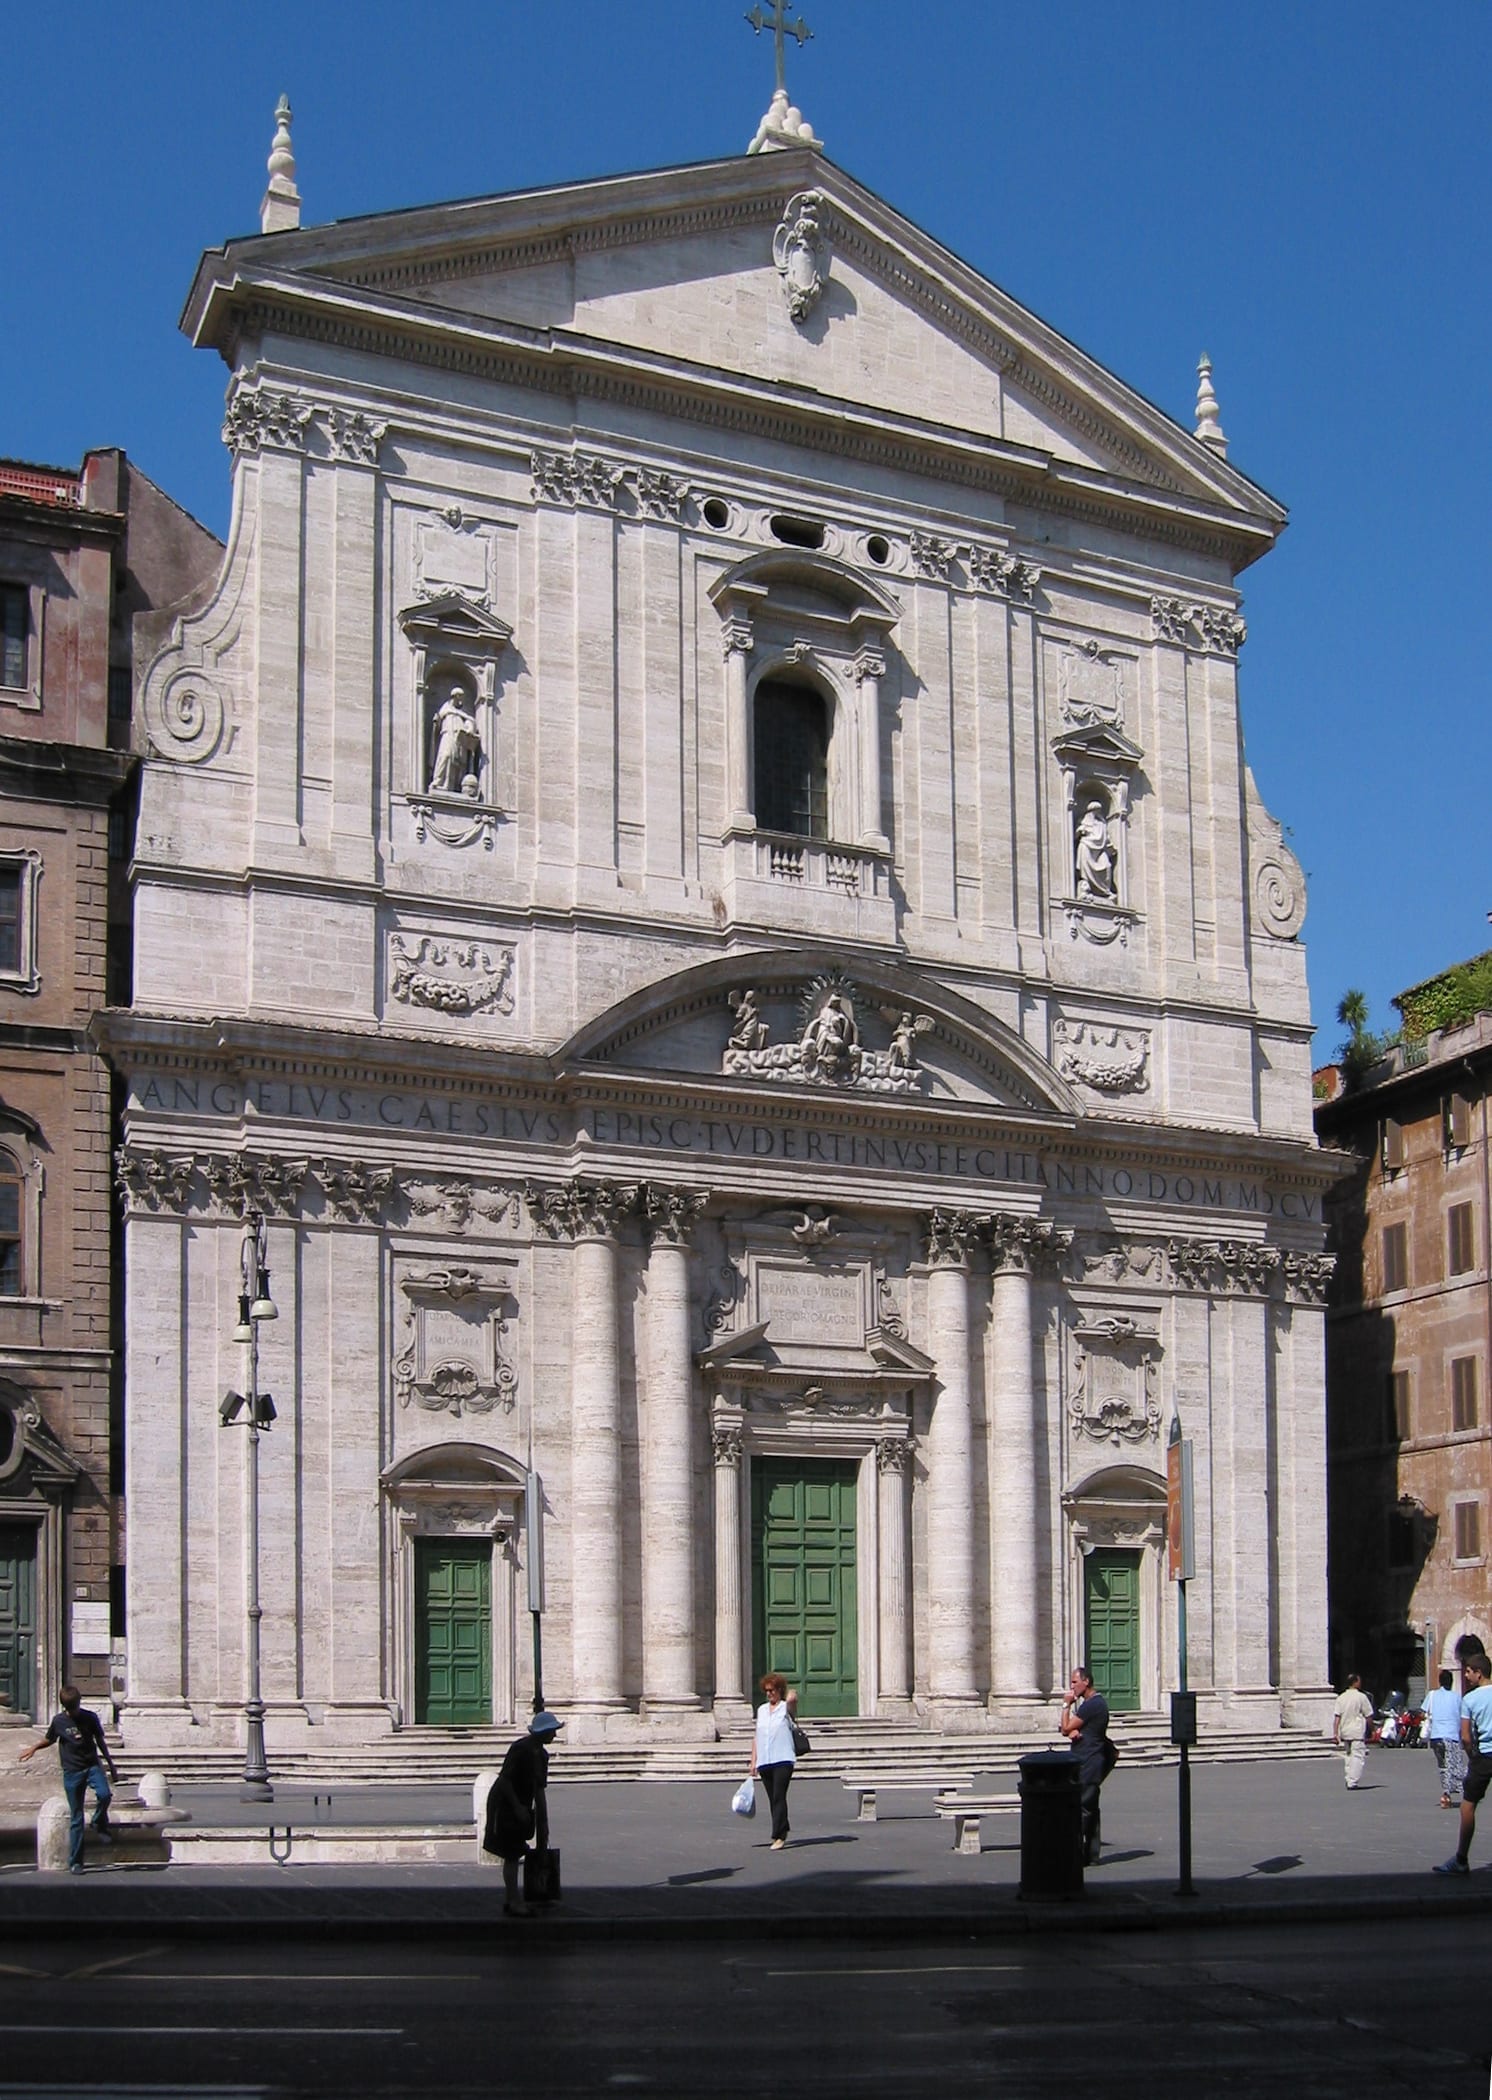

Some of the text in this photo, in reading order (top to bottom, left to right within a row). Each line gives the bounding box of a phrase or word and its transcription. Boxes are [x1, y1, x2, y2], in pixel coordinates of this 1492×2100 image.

[140, 1077, 352, 1120] ANGELVS
[379, 1095, 560, 1142] CAESIVS
[593, 1109, 692, 1148] EPISC
[701, 1121, 927, 1170] TVDERTINVS
[936, 1143, 1032, 1180] FECIT
[1036, 1162, 1133, 1196] ANNO
[1148, 1172, 1223, 1206] DOM
